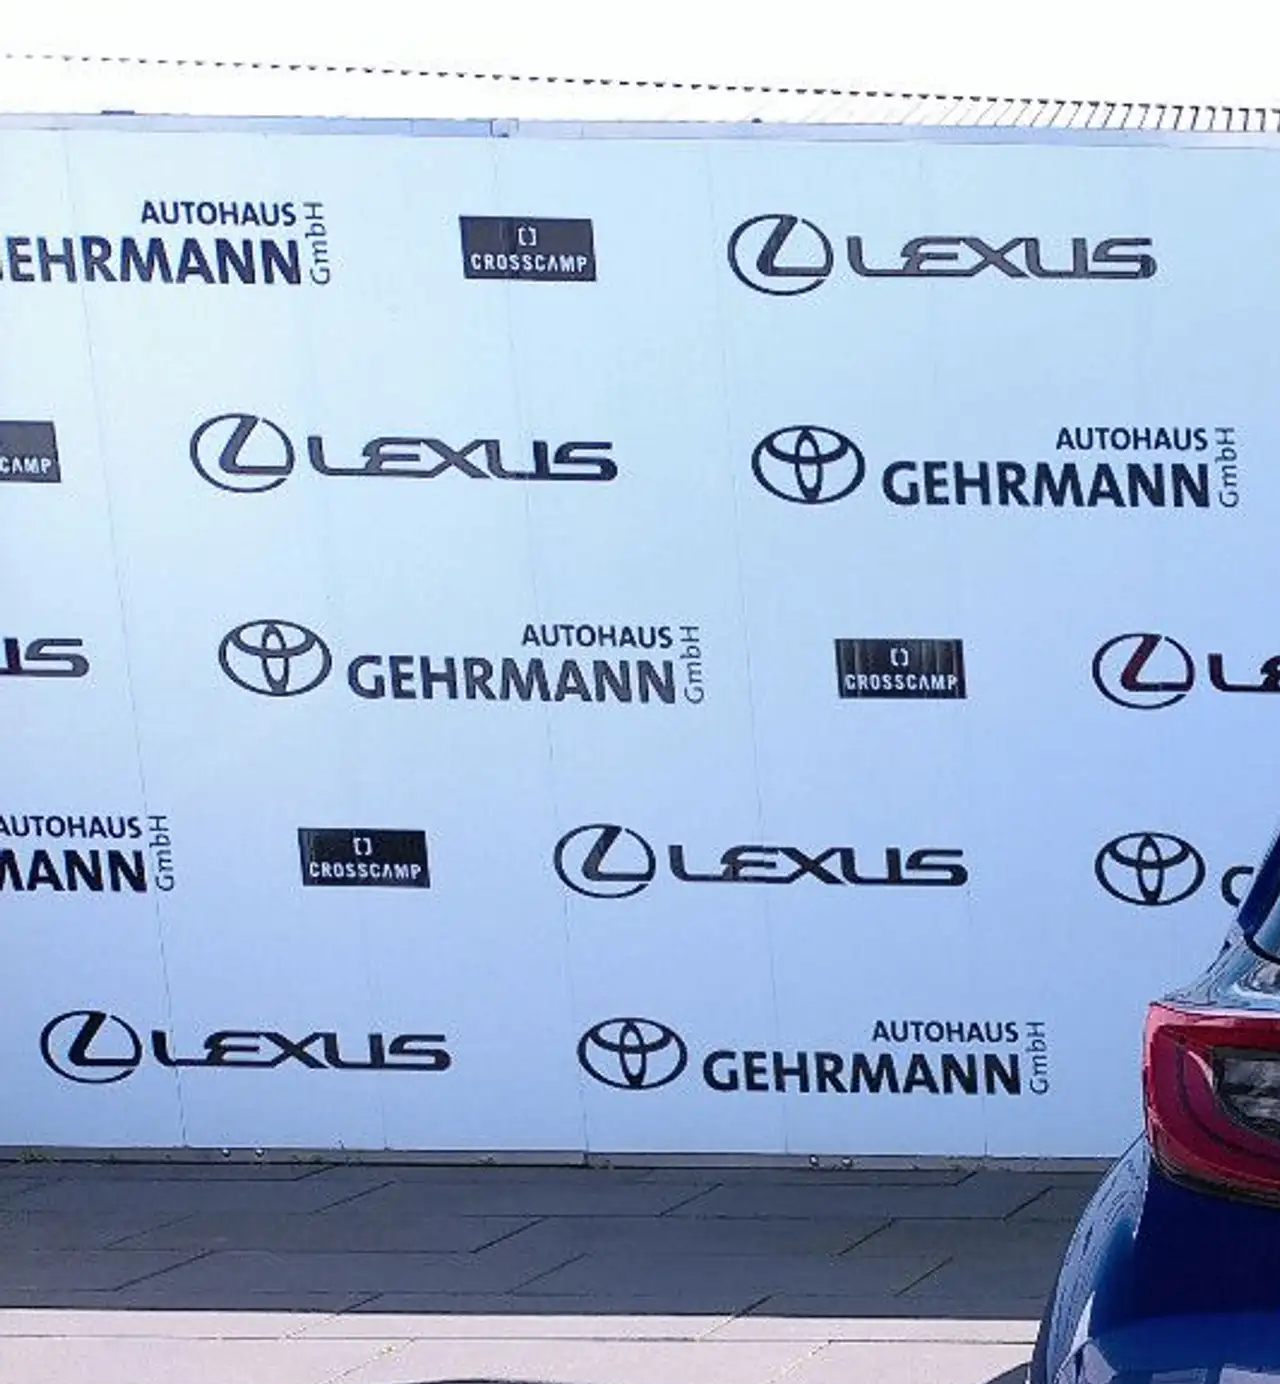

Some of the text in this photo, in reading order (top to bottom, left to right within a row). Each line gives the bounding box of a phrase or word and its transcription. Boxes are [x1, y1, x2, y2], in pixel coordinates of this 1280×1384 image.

[142, 201, 296, 226] AUTOHAUS
[0, 236, 301, 284] EHRMANN
[307, 203, 330, 285] GmbH
[471, 254, 587, 272] CROSSCAMP
[847, 236, 1157, 279] LEXUS
[308, 436, 618, 481] LEXUS
[1056, 428, 1208, 451] AUTOHAUS
[883, 461, 1210, 507] GEHRMANN
[1215, 428, 1239, 508] GmbH
[522, 624, 673, 649] AUTOHAUS
[348, 655, 675, 704] GEHRMANN
[681, 626, 704, 704] GmbH
[845, 674, 956, 691] CROSSCAMP
[0, 816, 142, 838] AUTOHAUS
[148, 816, 174, 891] GmbH
[310, 861, 421, 879] CROSSCAMP
[669, 845, 968, 886] LEXUS
[152, 1030, 451, 1071] LEXUS
[872, 1021, 1018, 1042] AUTOHAUS
[703, 1050, 1020, 1095] GEHRMANN
[1026, 1022, 1049, 1095] GmbH
